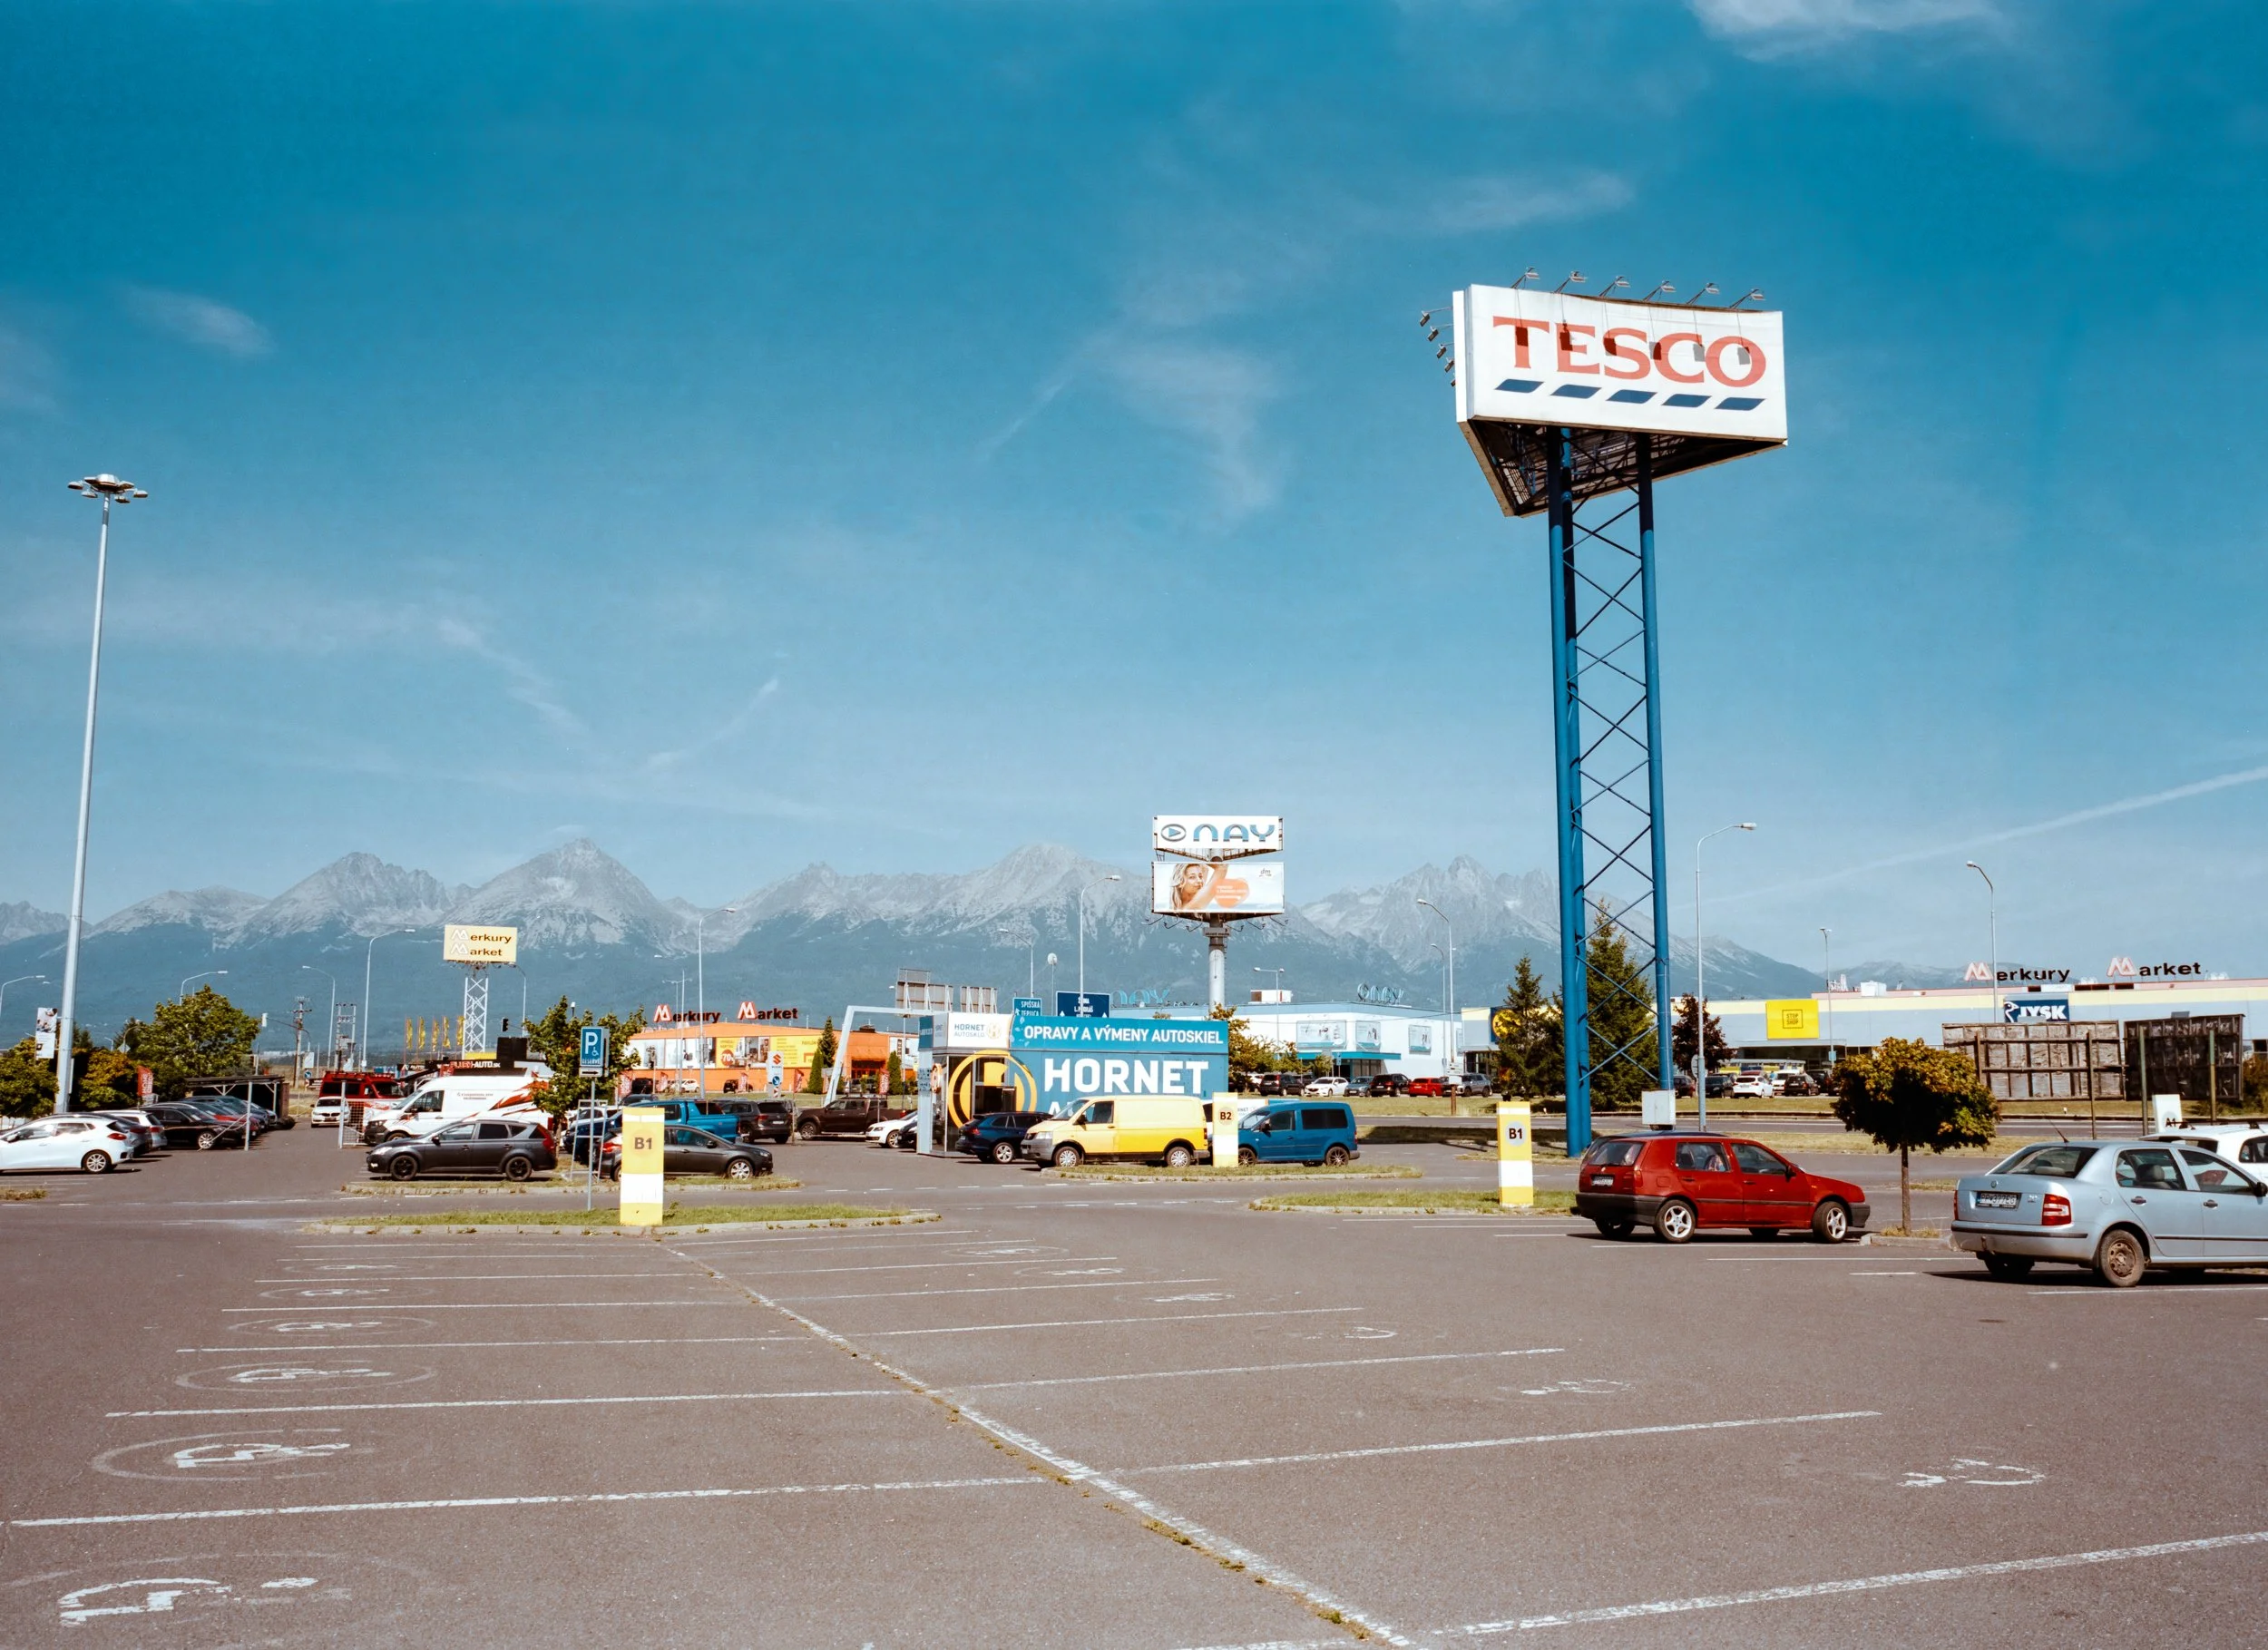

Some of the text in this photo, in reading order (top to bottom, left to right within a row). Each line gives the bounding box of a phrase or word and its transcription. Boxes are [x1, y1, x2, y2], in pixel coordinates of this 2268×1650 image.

[1492, 315, 1766, 388] TESCO
[2018, 1005, 2067, 1020] JYSK
[954, 1023, 985, 1031] HORNET
[1024, 1024, 1224, 1044] OPRAVY A VÝMENY AUTOSKIEL
[1044, 1058, 1209, 1094] HORNET
[1219, 1111, 1232, 1120] B2
[2165, 1117, 2176, 1128] A1
[1509, 1127, 1523, 1140] B1
[634, 1137, 653, 1150] B1
